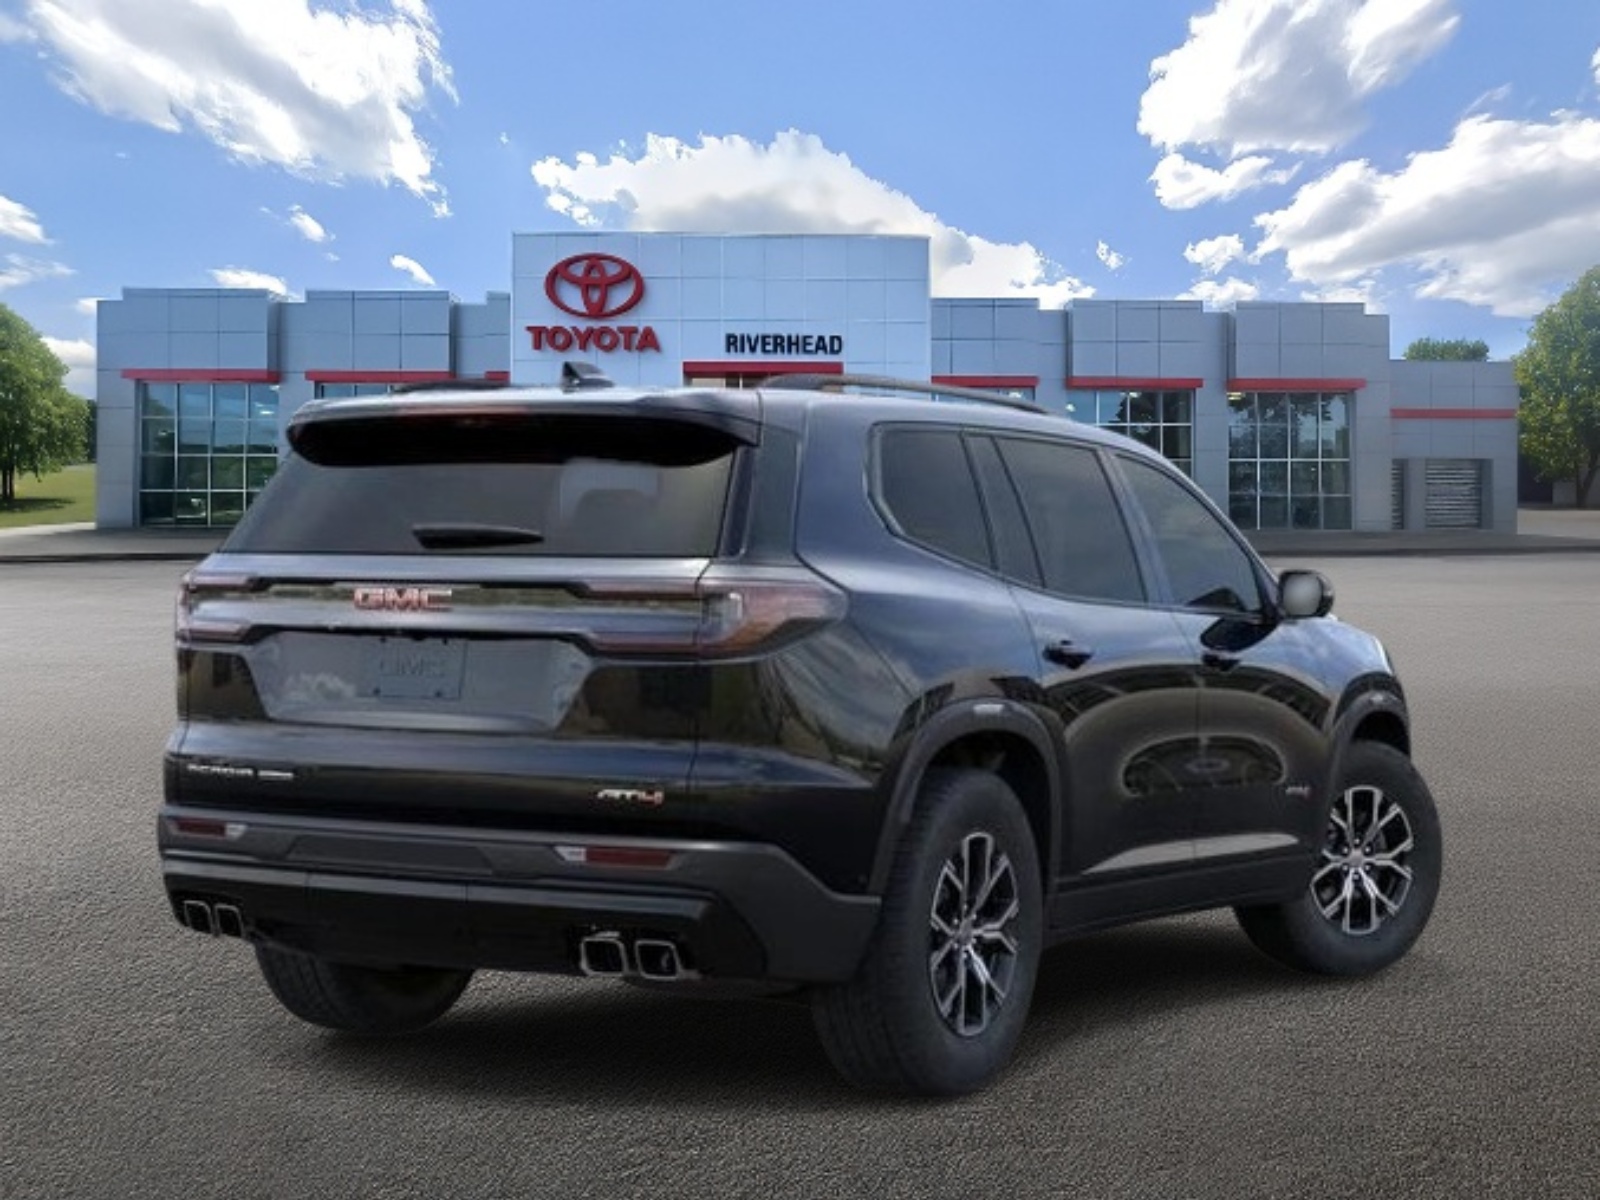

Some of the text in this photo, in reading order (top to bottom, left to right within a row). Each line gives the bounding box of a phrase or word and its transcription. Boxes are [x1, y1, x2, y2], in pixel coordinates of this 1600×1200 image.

[525, 325, 662, 353] TOYOTA
[725, 333, 843, 356] RIVERHEAD
[353, 587, 453, 611] GMC
